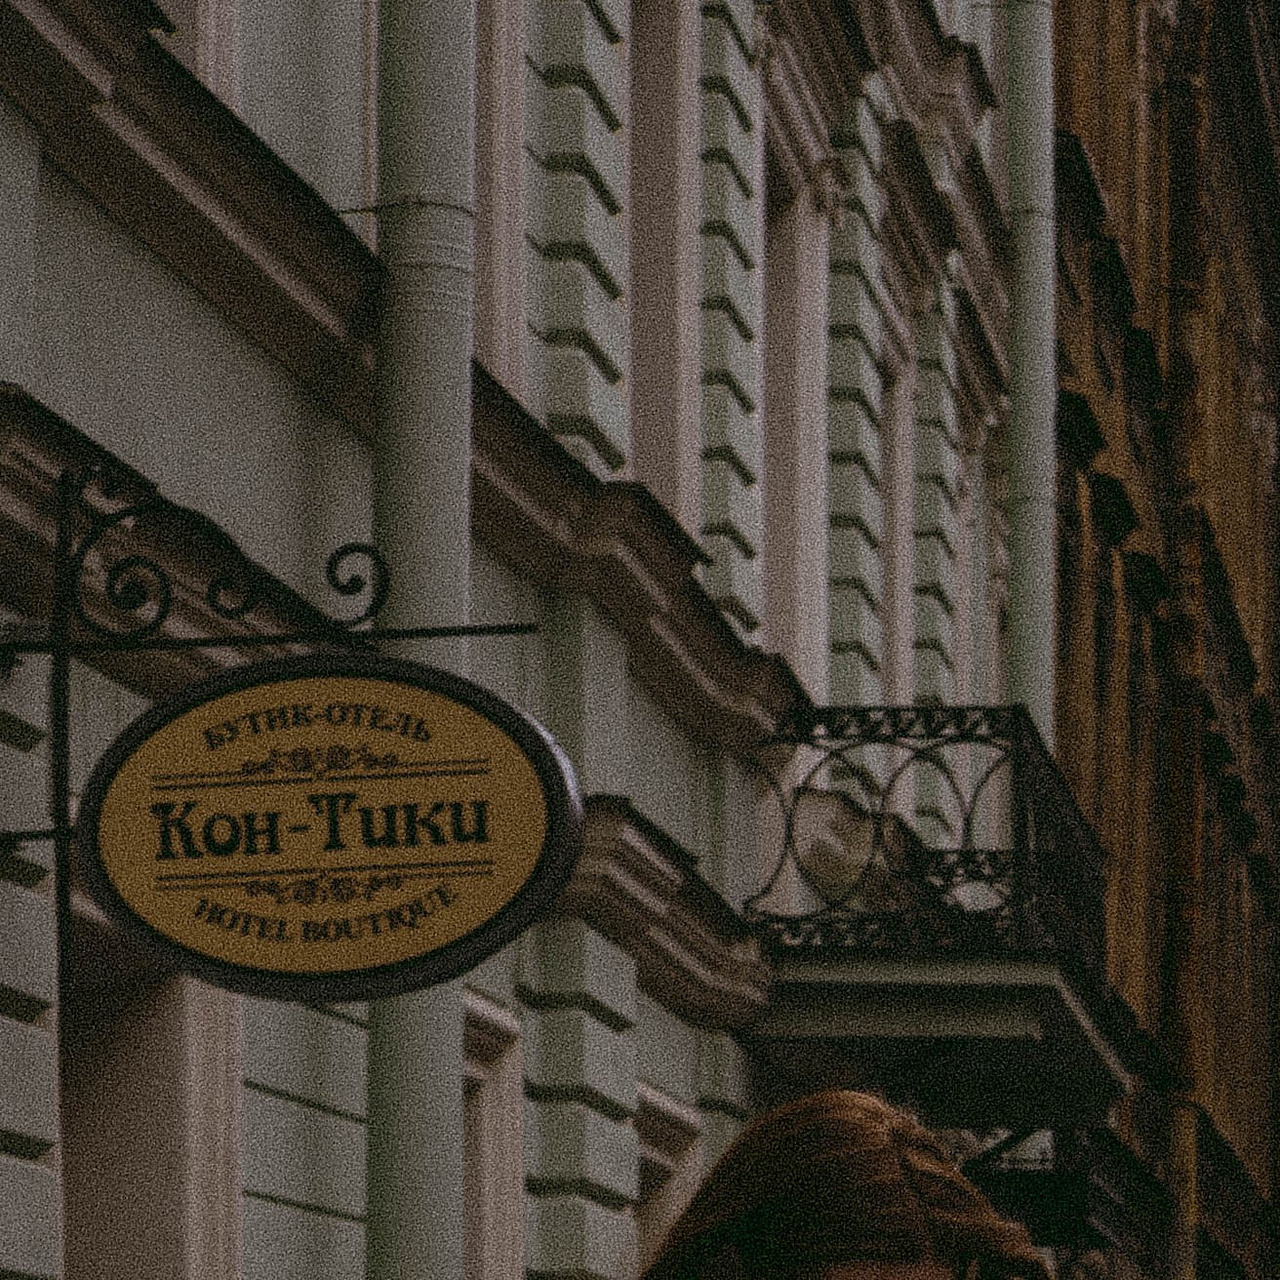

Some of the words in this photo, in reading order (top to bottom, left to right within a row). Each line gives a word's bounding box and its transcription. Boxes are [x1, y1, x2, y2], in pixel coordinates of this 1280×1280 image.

[203, 702, 431, 750] БУТИК-ОТЕЛЬ
[150, 793, 490, 860] Кон-Тики
[195, 899, 292, 942] HOTEL
[302, 883, 458, 943] BOUTIQUE
